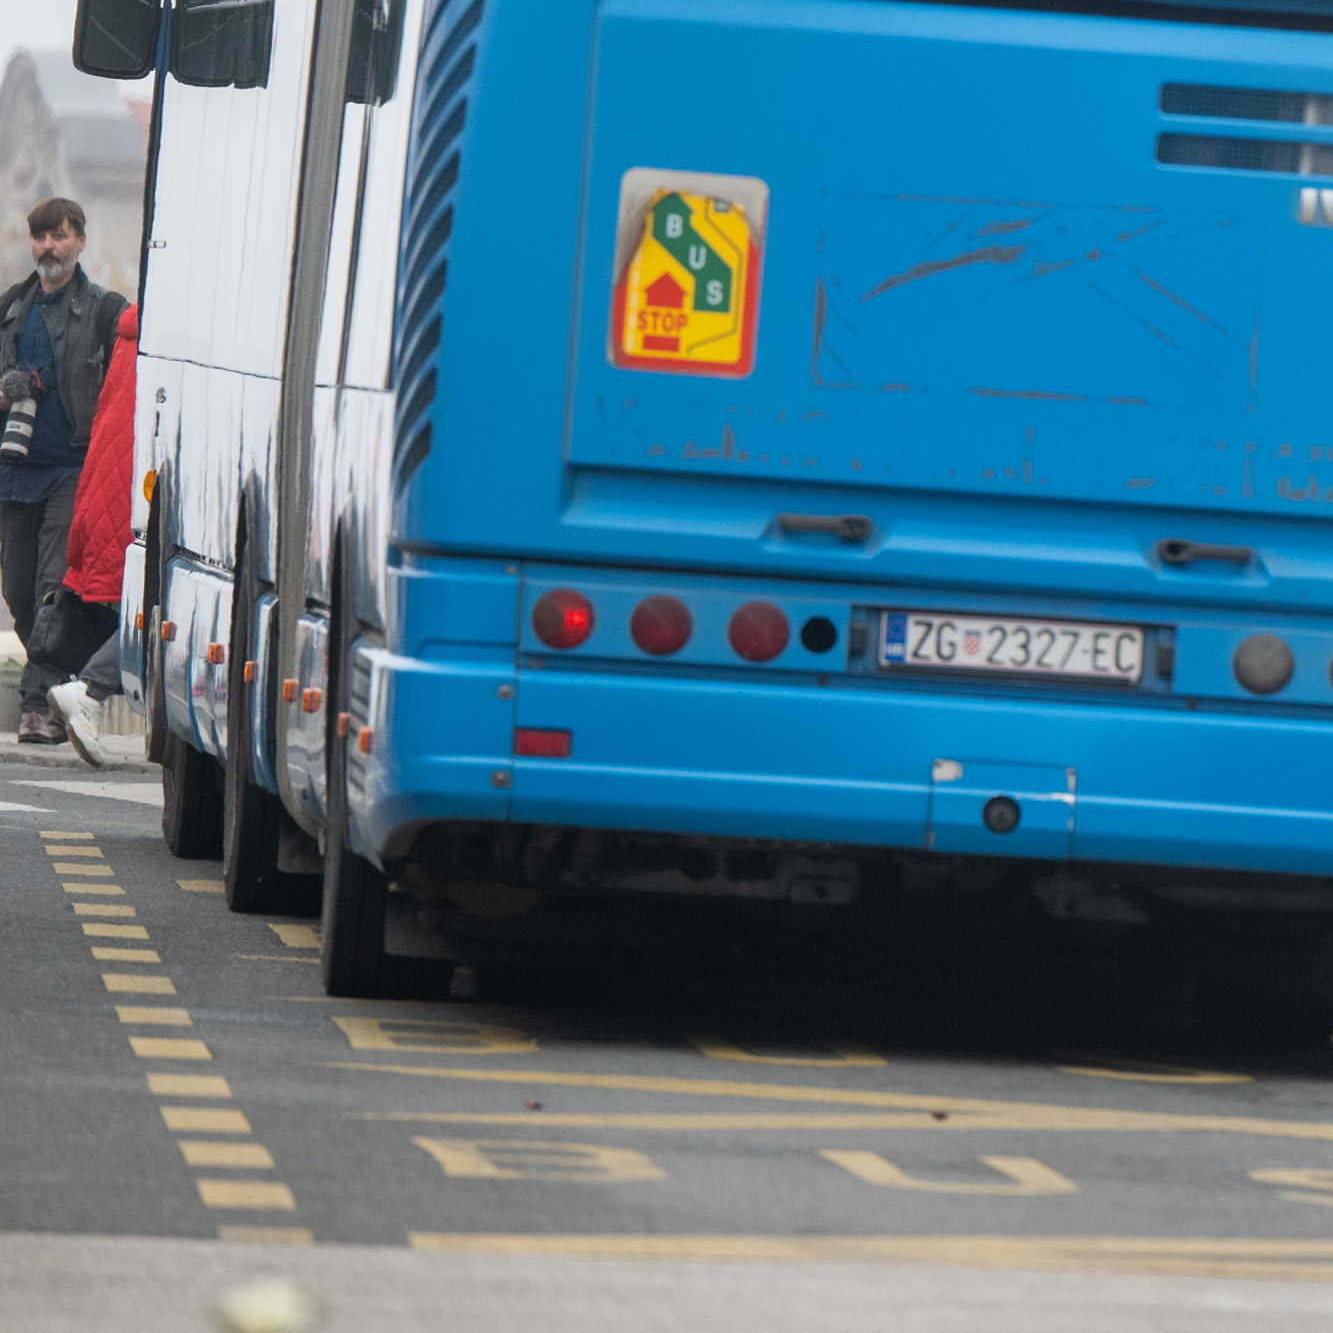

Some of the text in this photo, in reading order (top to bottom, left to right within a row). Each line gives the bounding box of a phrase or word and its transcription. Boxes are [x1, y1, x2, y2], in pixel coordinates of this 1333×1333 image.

[664, 212, 725, 306] BUS
[637, 310, 689, 333] STOP
[911, 619, 958, 662] ZG
[986, 625, 1138, 673] 2327-EC
